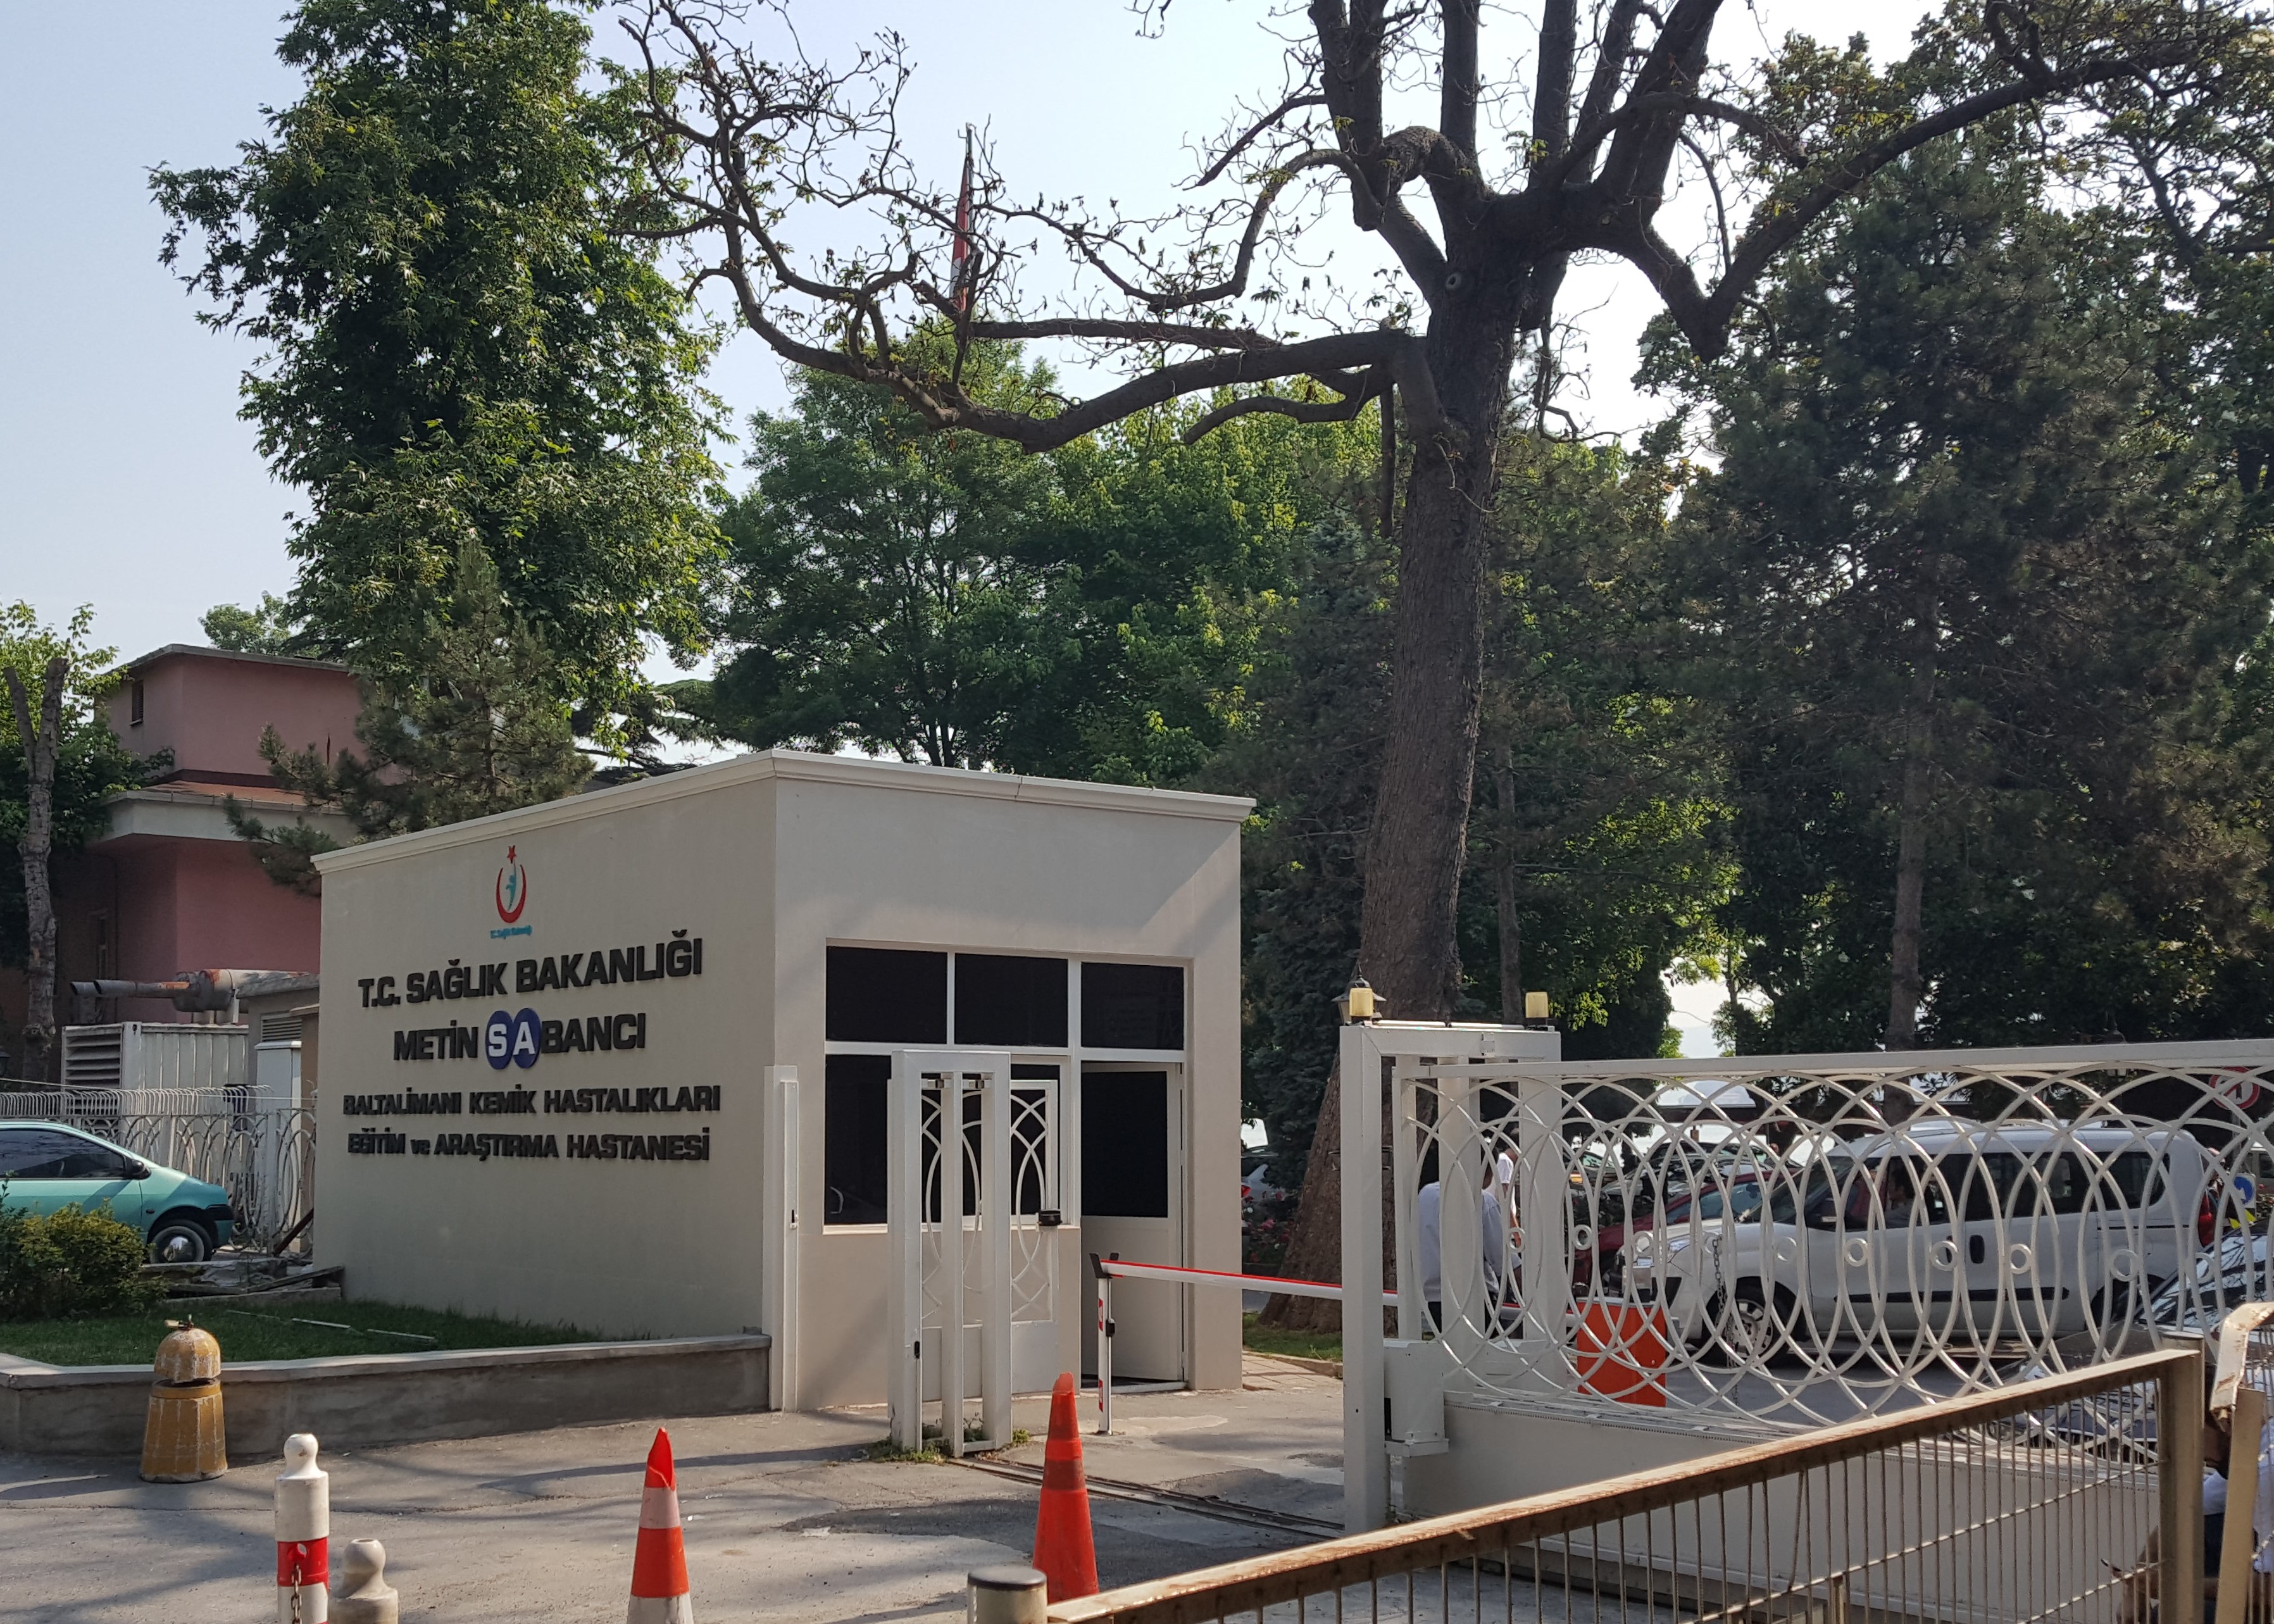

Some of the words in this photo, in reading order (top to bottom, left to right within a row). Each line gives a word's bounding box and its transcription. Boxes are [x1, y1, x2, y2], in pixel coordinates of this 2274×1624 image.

[358, 976, 401, 1008] T.C.
[406, 959, 508, 1004] SAĞLIK
[516, 928, 703, 994] BAKANLIĞI
[394, 1020, 479, 1061] METİN
[343, 1087, 462, 1116] BALTALİMANI
[469, 1084, 537, 1115] KEMİK
[544, 1085, 721, 1115] HASTALIKLARI
[347, 1127, 406, 1156] EĞİTİM
[410, 1139, 431, 1156] ve
[434, 1133, 560, 1163] ARAŞTIRMA
[566, 1127, 710, 1163] HASTANESİ
